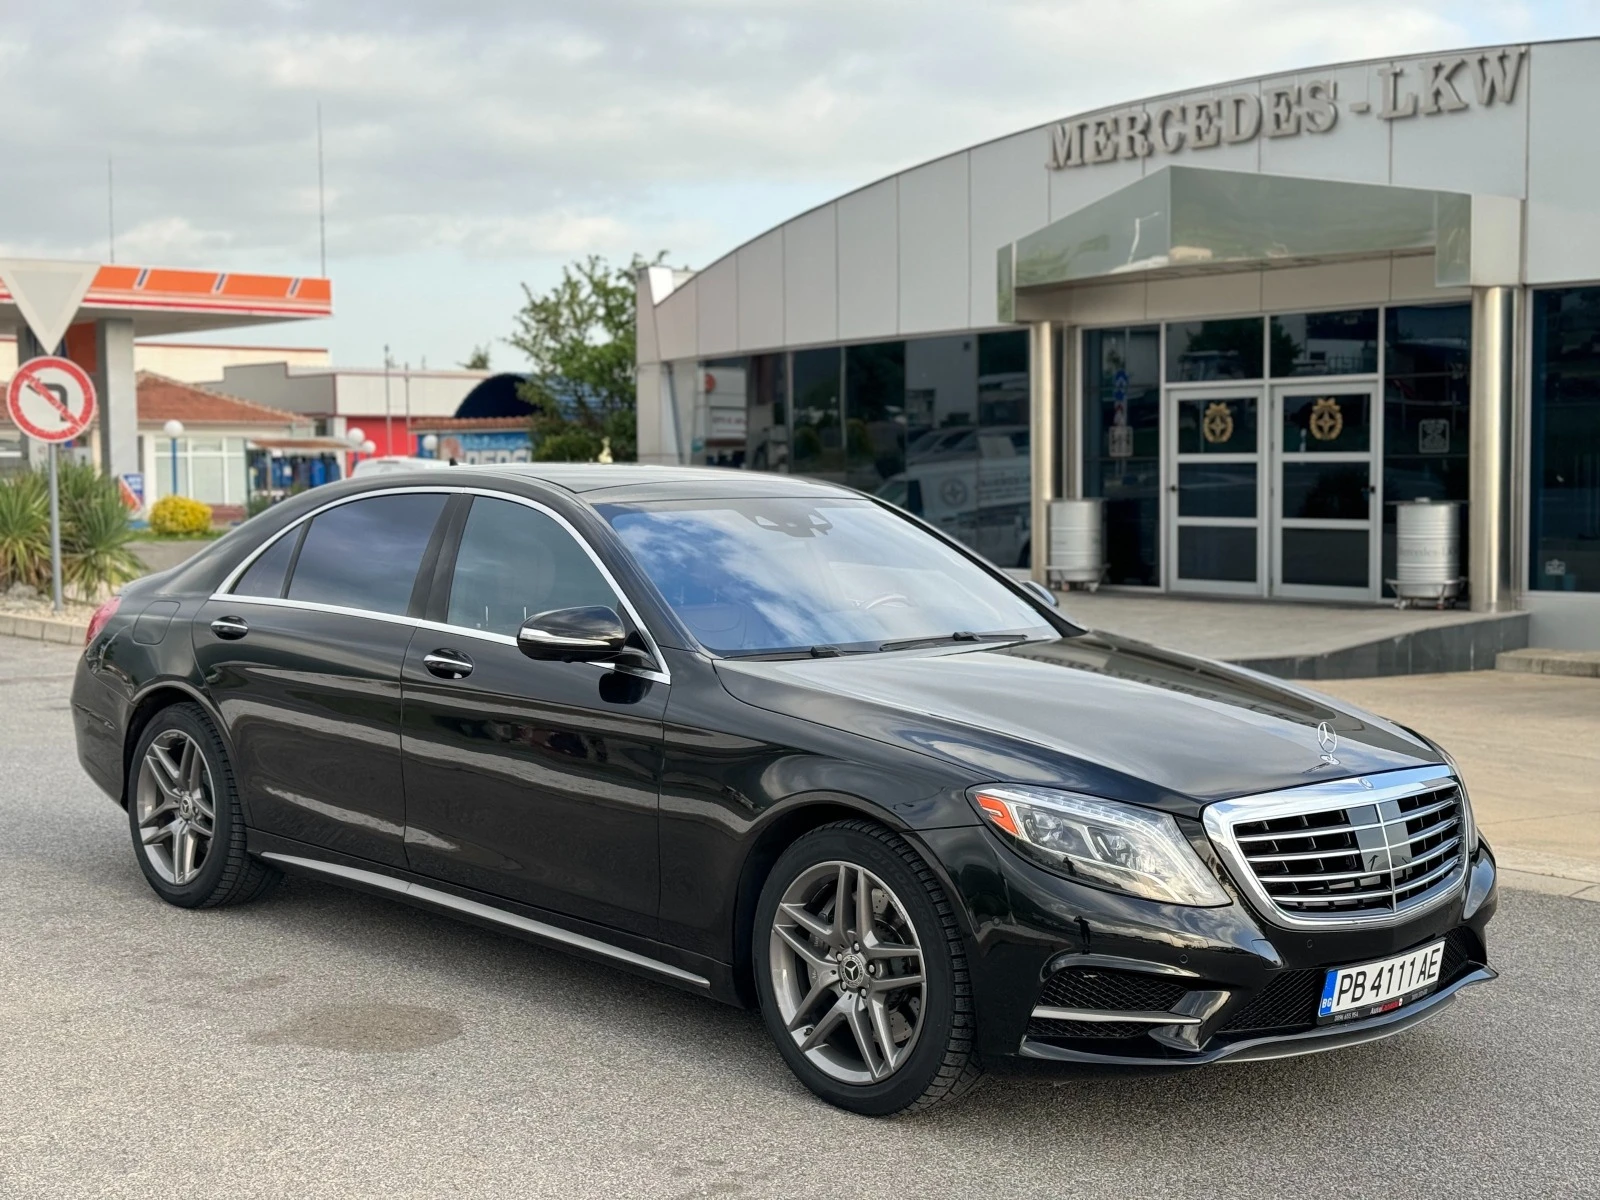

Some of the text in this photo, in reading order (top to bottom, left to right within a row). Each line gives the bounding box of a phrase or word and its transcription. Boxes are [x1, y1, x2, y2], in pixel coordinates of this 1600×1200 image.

[1336, 947, 1441, 1006] PB 4111 AE
[1321, 997, 1333, 1009] BG
